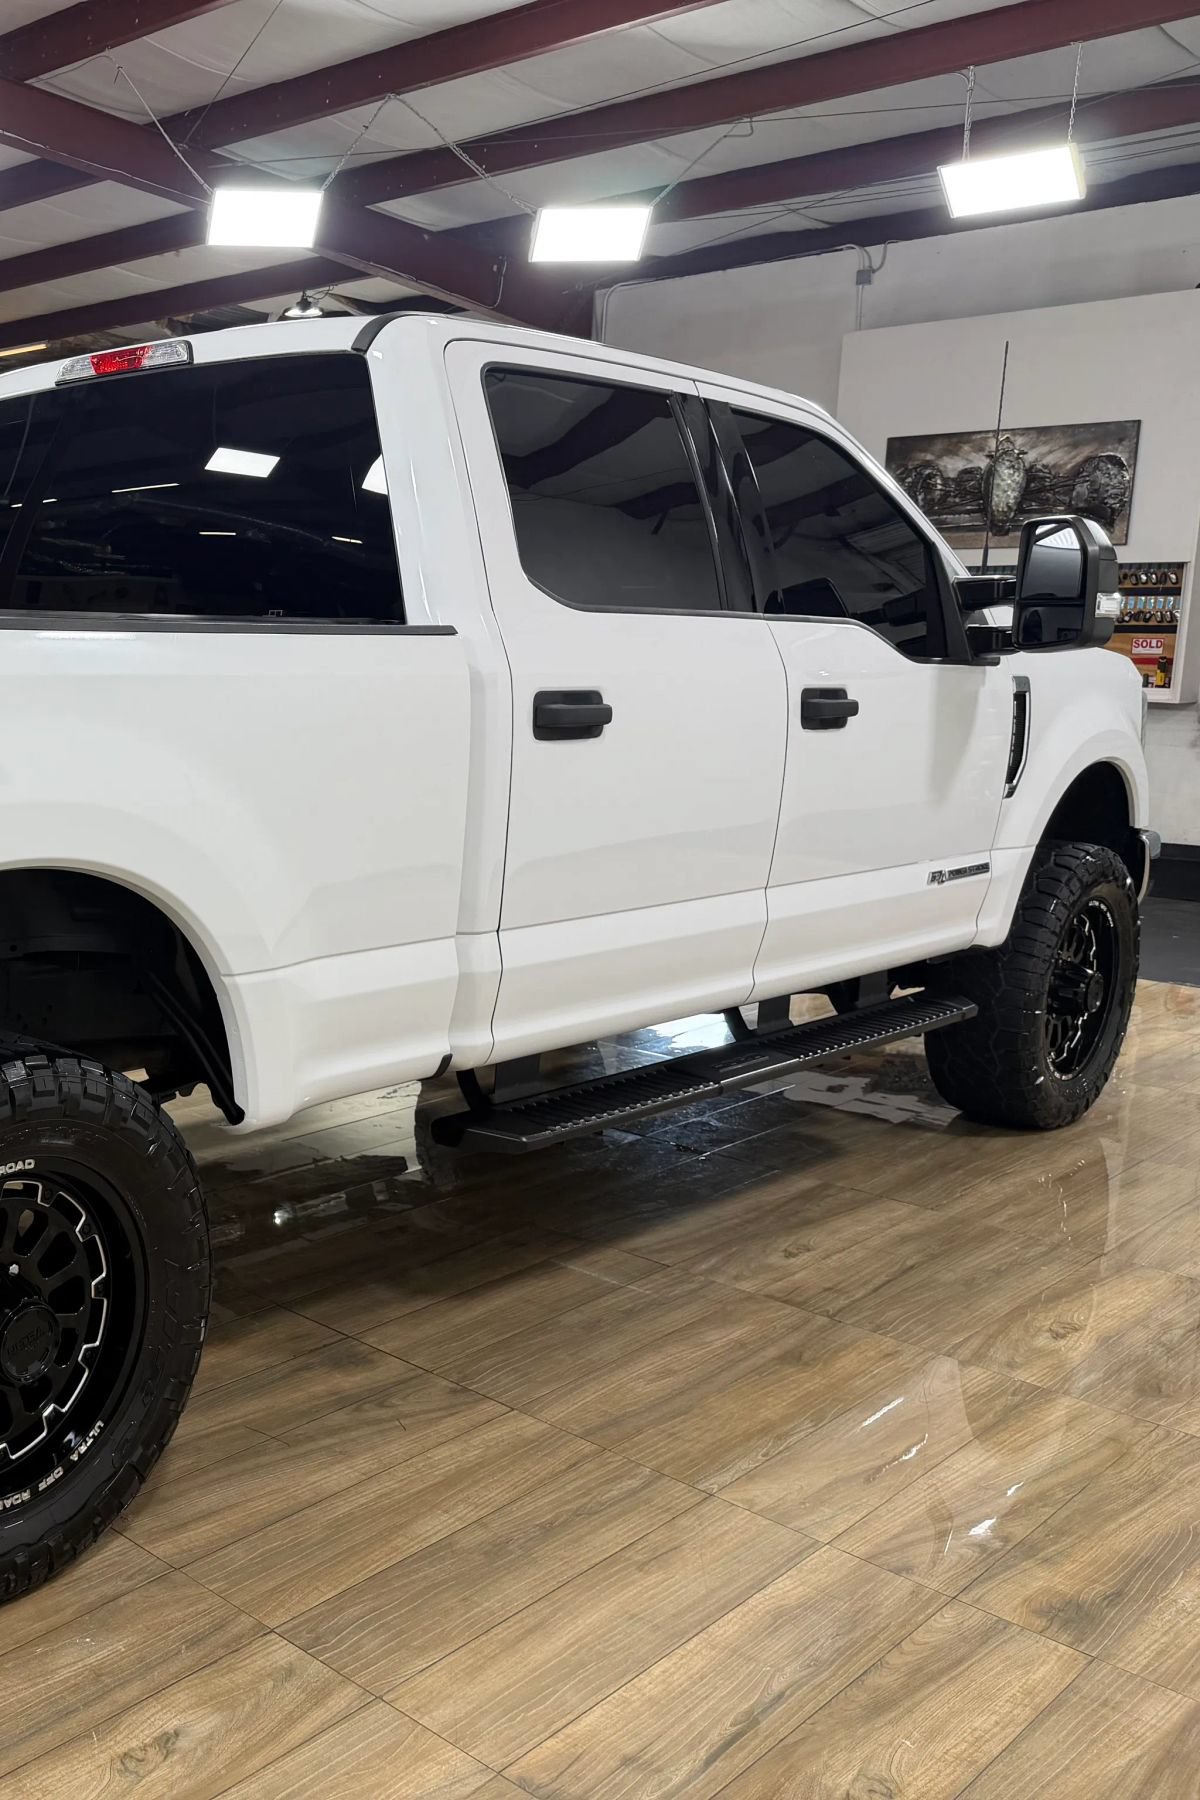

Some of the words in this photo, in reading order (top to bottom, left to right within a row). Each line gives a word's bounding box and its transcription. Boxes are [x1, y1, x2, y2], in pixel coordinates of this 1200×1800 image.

[1133, 639, 1163, 649] SOLD
[69, 1420, 104, 1461] ULTRA
[38, 1466, 64, 1491] OFF
